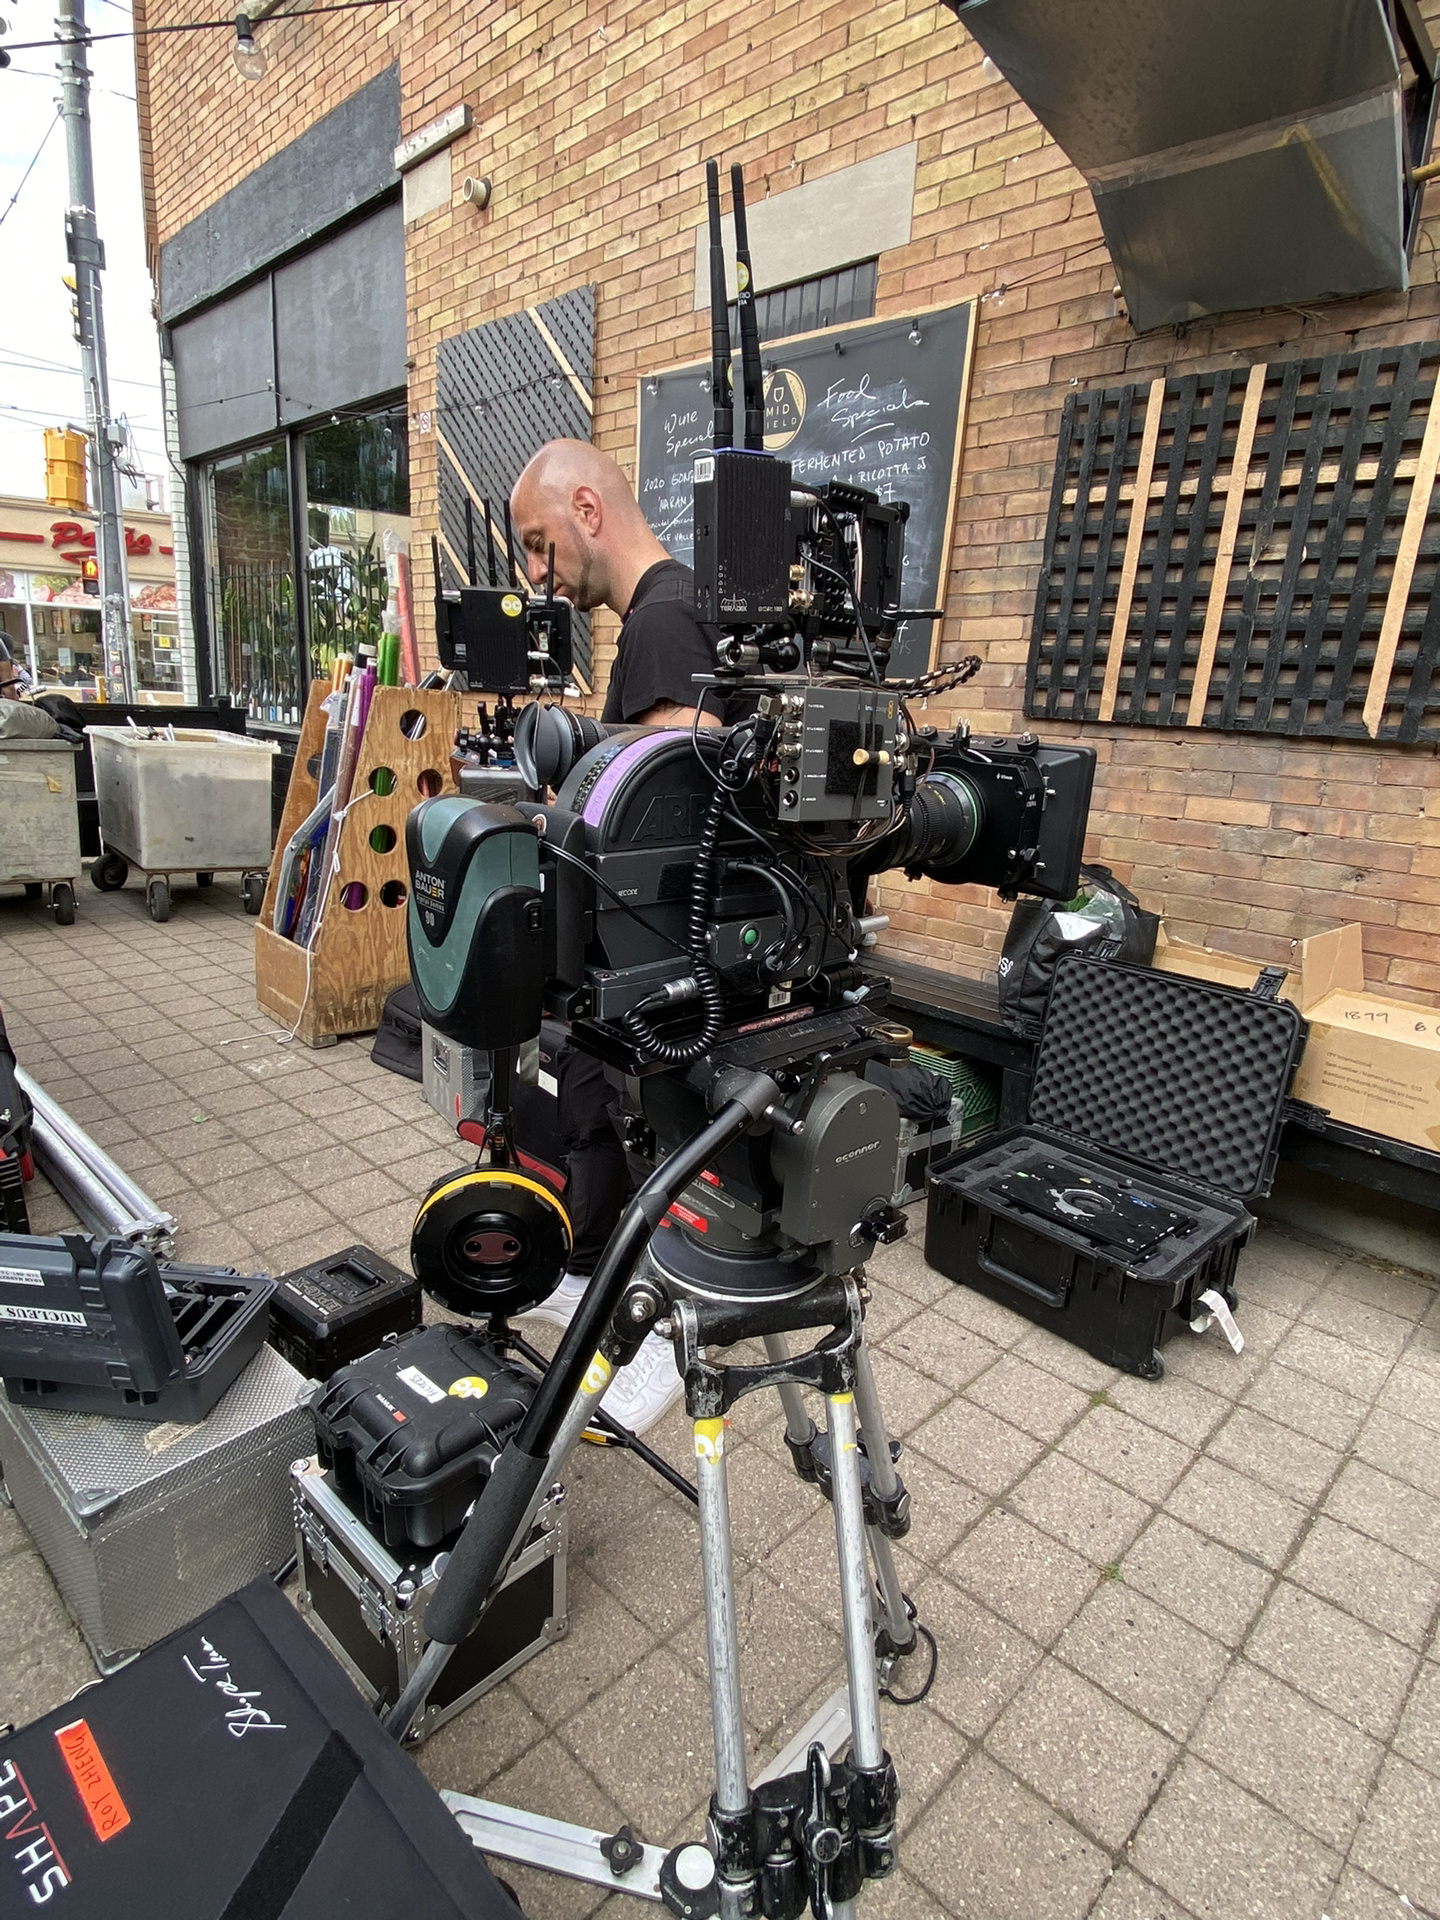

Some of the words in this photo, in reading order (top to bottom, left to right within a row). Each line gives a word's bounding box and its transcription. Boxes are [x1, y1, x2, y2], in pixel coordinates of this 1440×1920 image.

[817, 373, 877, 408] Food
[766, 403, 790, 417] MID
[664, 411, 698, 434] Wine
[766, 417, 797, 429] IELD
[791, 446, 866, 475] FERMENTED
[878, 432, 930, 458] POTATO
[859, 462, 910, 484] RICOTTA
[643, 478, 666, 493] 2020
[415, 869, 446, 890] ANTON
[415, 879, 445, 900] BAUER
[424, 910, 435, 927] 90
[834, 1140, 882, 1164] oconnor
[6, 1307, 84, 1325] NUCLEUS
